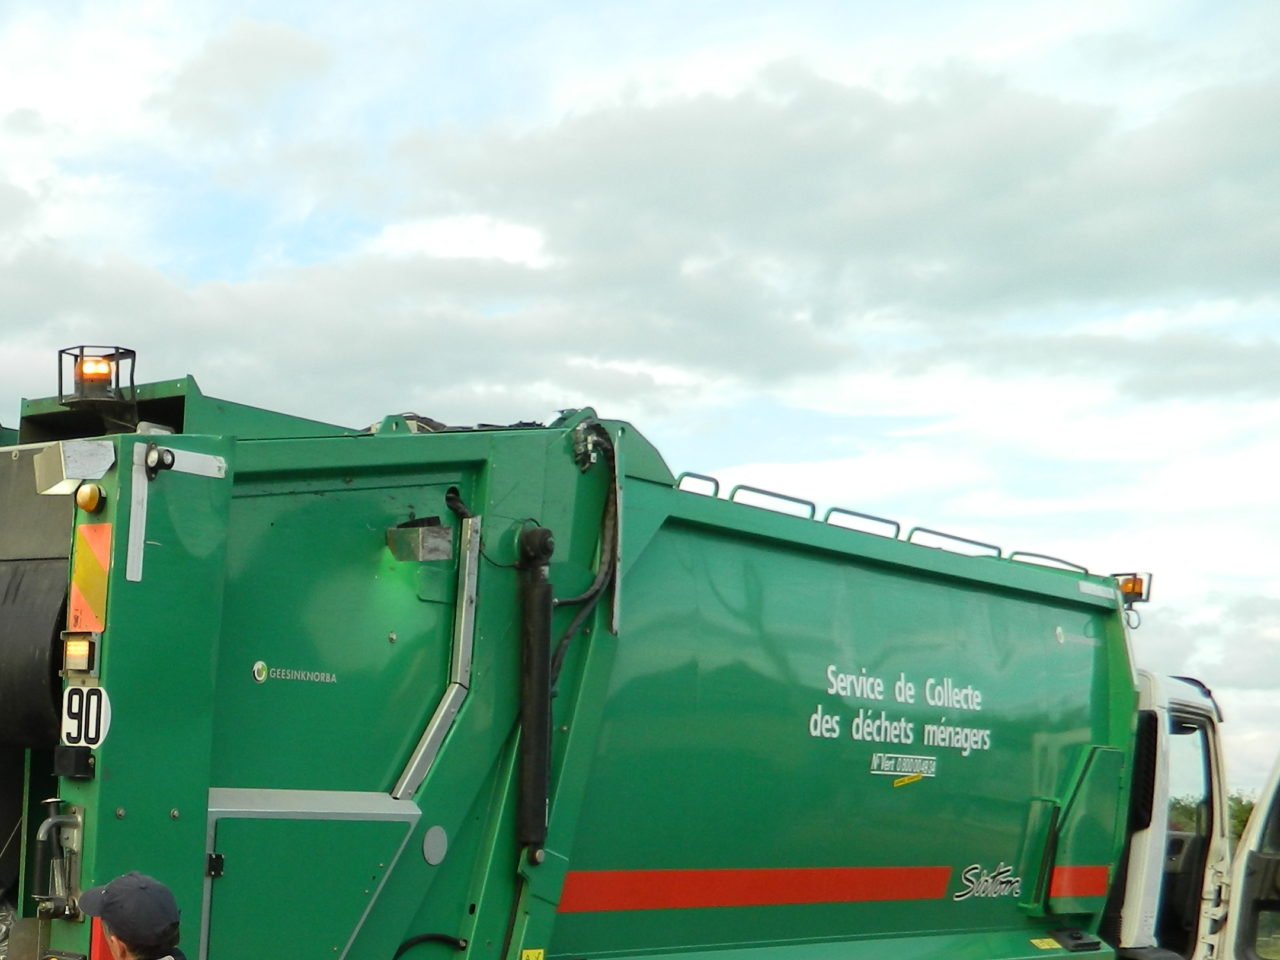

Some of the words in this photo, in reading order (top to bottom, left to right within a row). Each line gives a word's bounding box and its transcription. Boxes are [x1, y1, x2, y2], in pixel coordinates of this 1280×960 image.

[269, 668, 337, 683] GEESINKNORBA
[826, 664, 884, 700] Service
[894, 672, 915, 704] de
[925, 677, 982, 711] Collecte
[66, 688, 102, 745] 90
[809, 704, 840, 738] des
[851, 708, 914, 744] déchets
[923, 716, 990, 757] ménagers
[953, 862, 1021, 901] Sirtom
